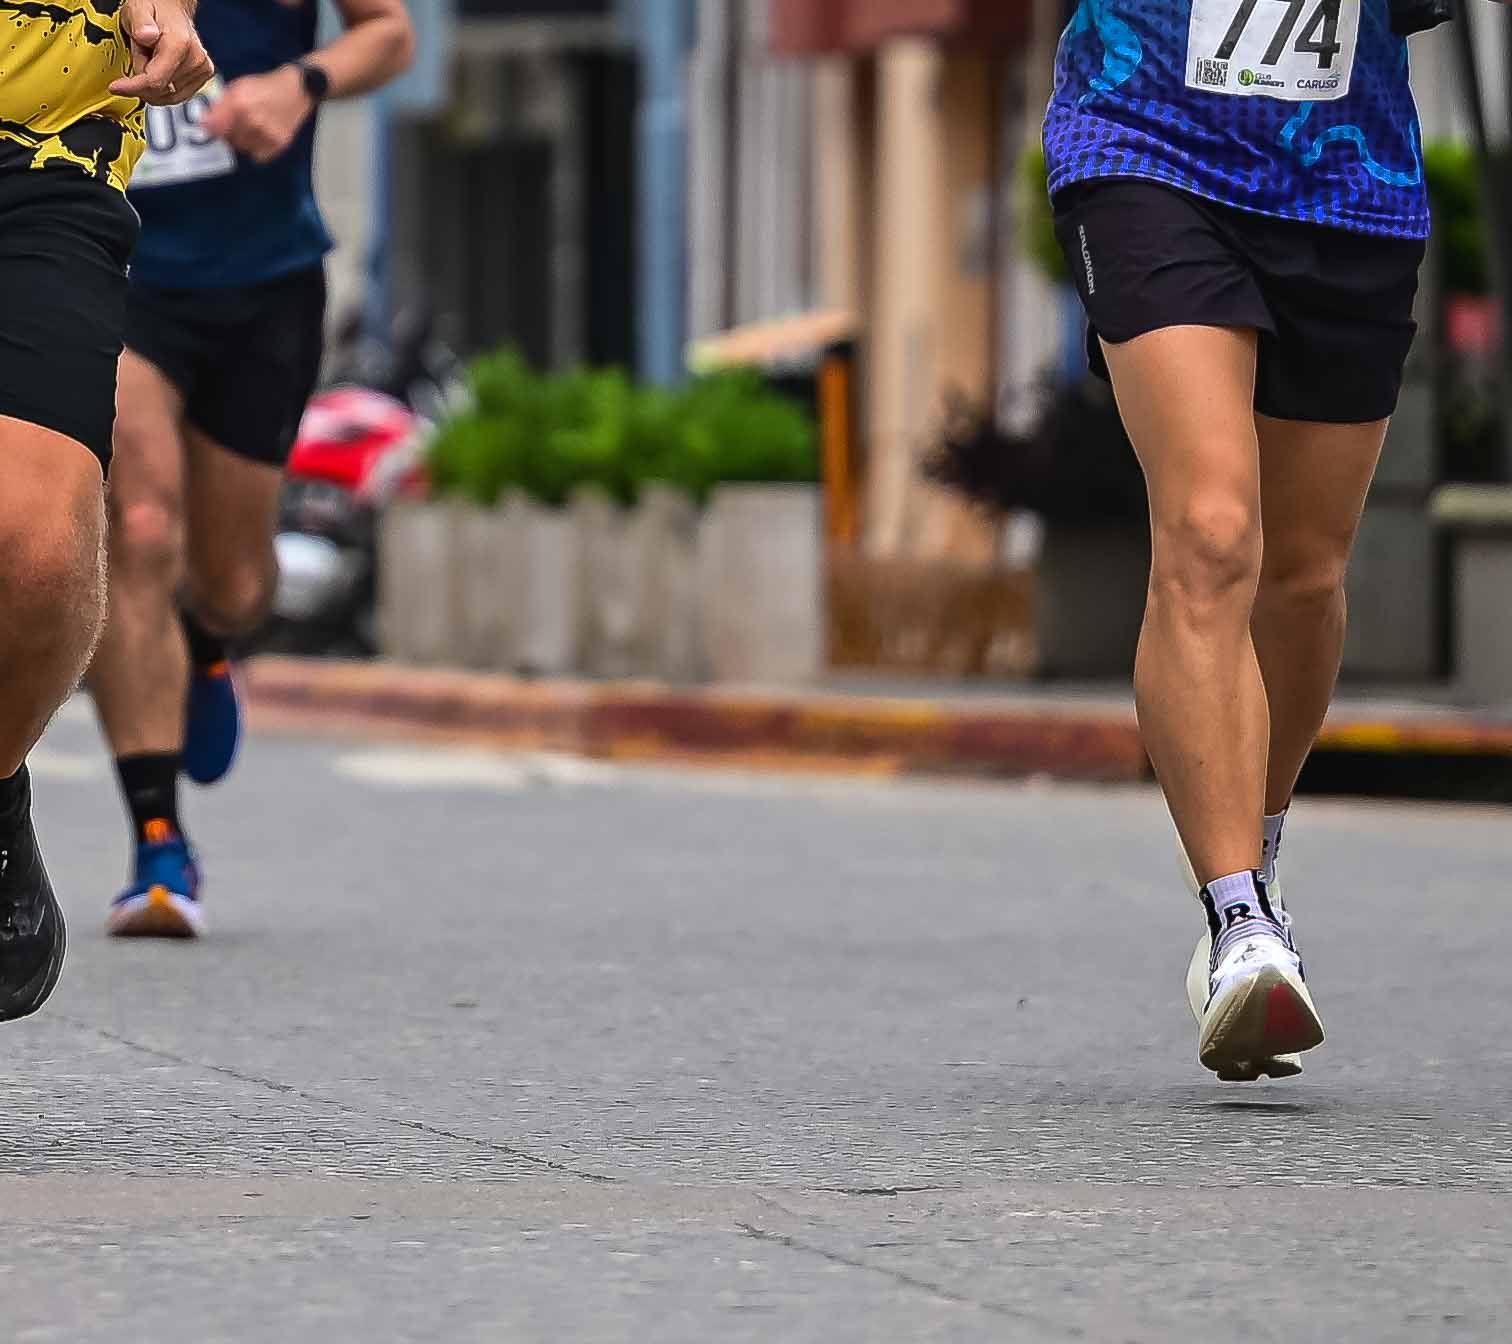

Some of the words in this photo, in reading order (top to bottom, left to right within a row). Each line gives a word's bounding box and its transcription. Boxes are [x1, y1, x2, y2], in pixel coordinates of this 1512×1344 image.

[1297, 79, 1339, 89] CARUSO
[145, 93, 210, 152] 09
[1078, 224, 1095, 295] SALOMON
